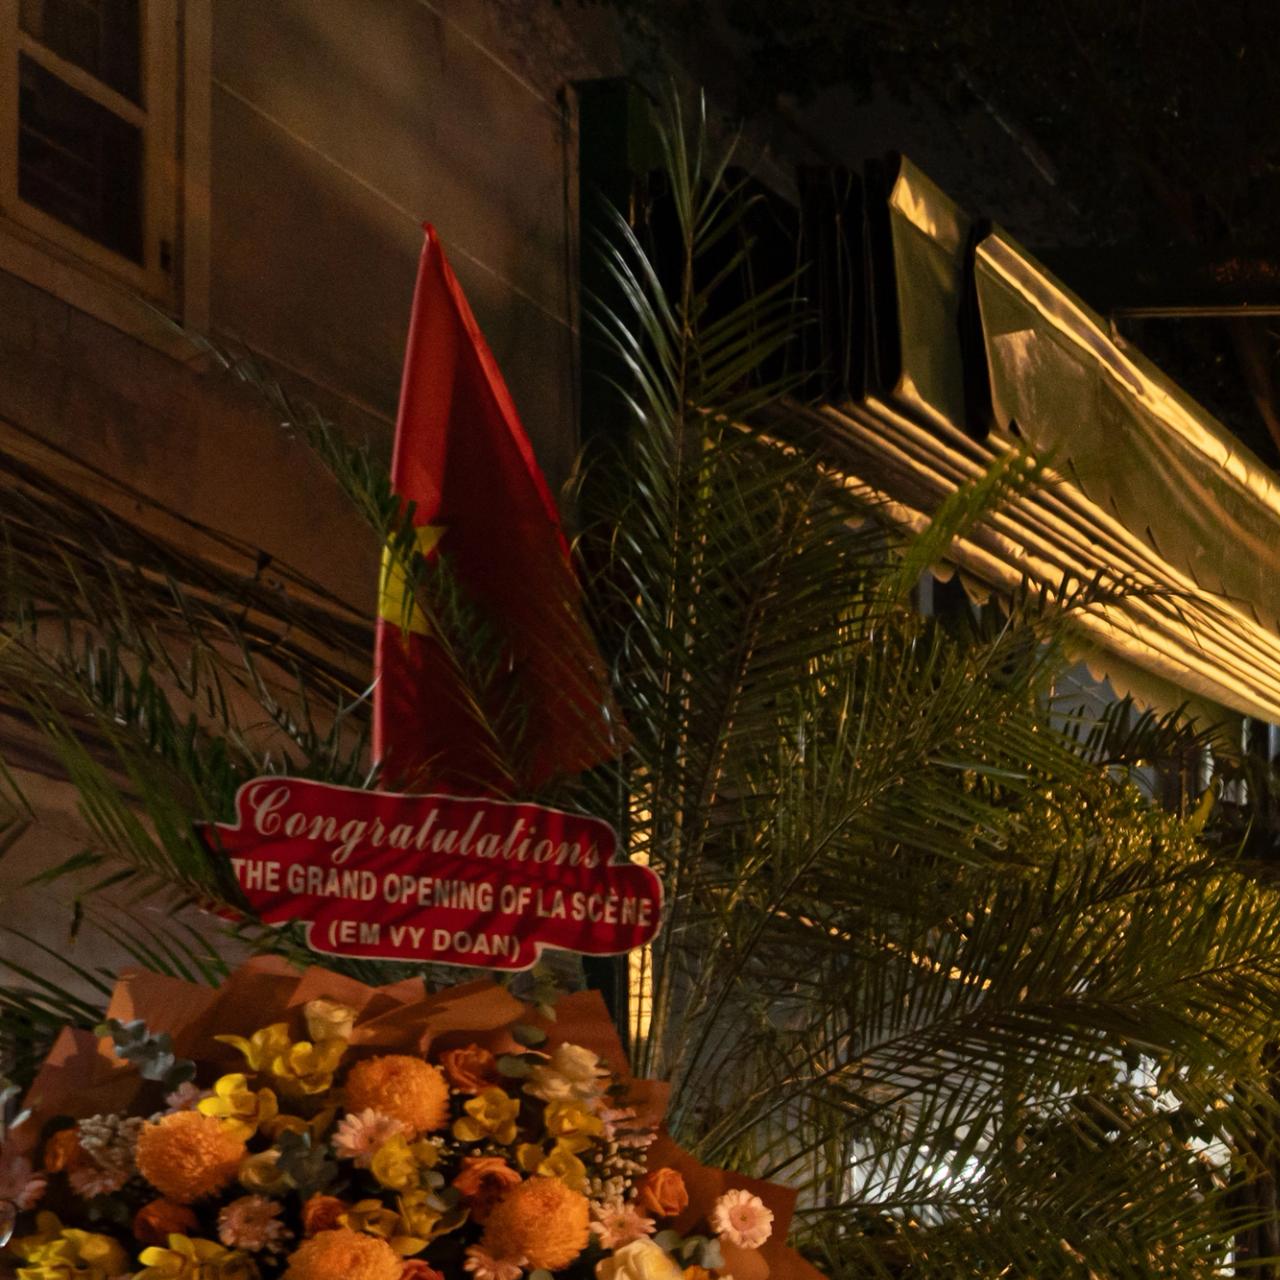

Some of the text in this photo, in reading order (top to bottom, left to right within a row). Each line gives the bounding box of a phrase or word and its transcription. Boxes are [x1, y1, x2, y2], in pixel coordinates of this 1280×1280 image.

[247, 783, 601, 869] Congratulations
[230, 858, 653, 927] THE GRAND OPENING OF LA SCÈNE
[328, 919, 520, 963] (EM VY DOAN)
